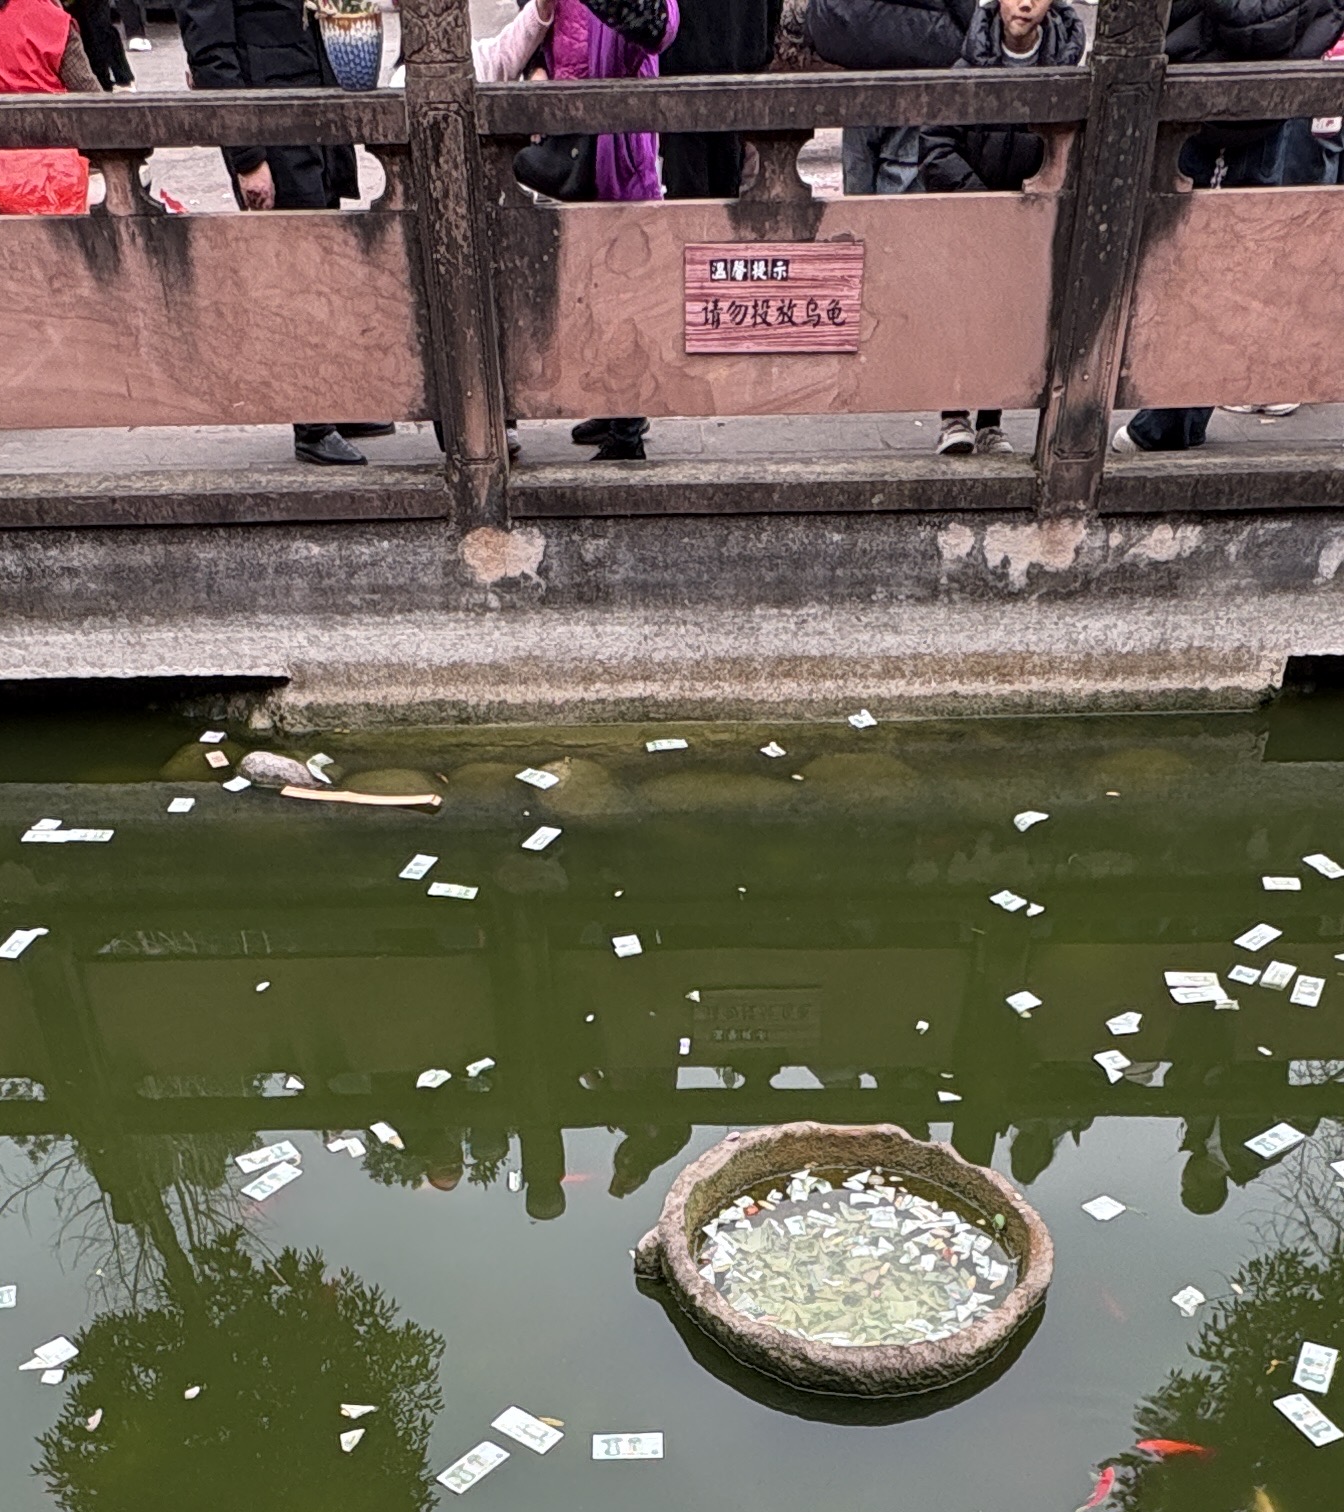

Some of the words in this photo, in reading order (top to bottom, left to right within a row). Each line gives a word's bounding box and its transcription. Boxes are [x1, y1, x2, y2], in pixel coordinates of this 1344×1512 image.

[710, 259, 789, 281] 温馨提示
[701, 297, 847, 329] 请勿投放乌龟
